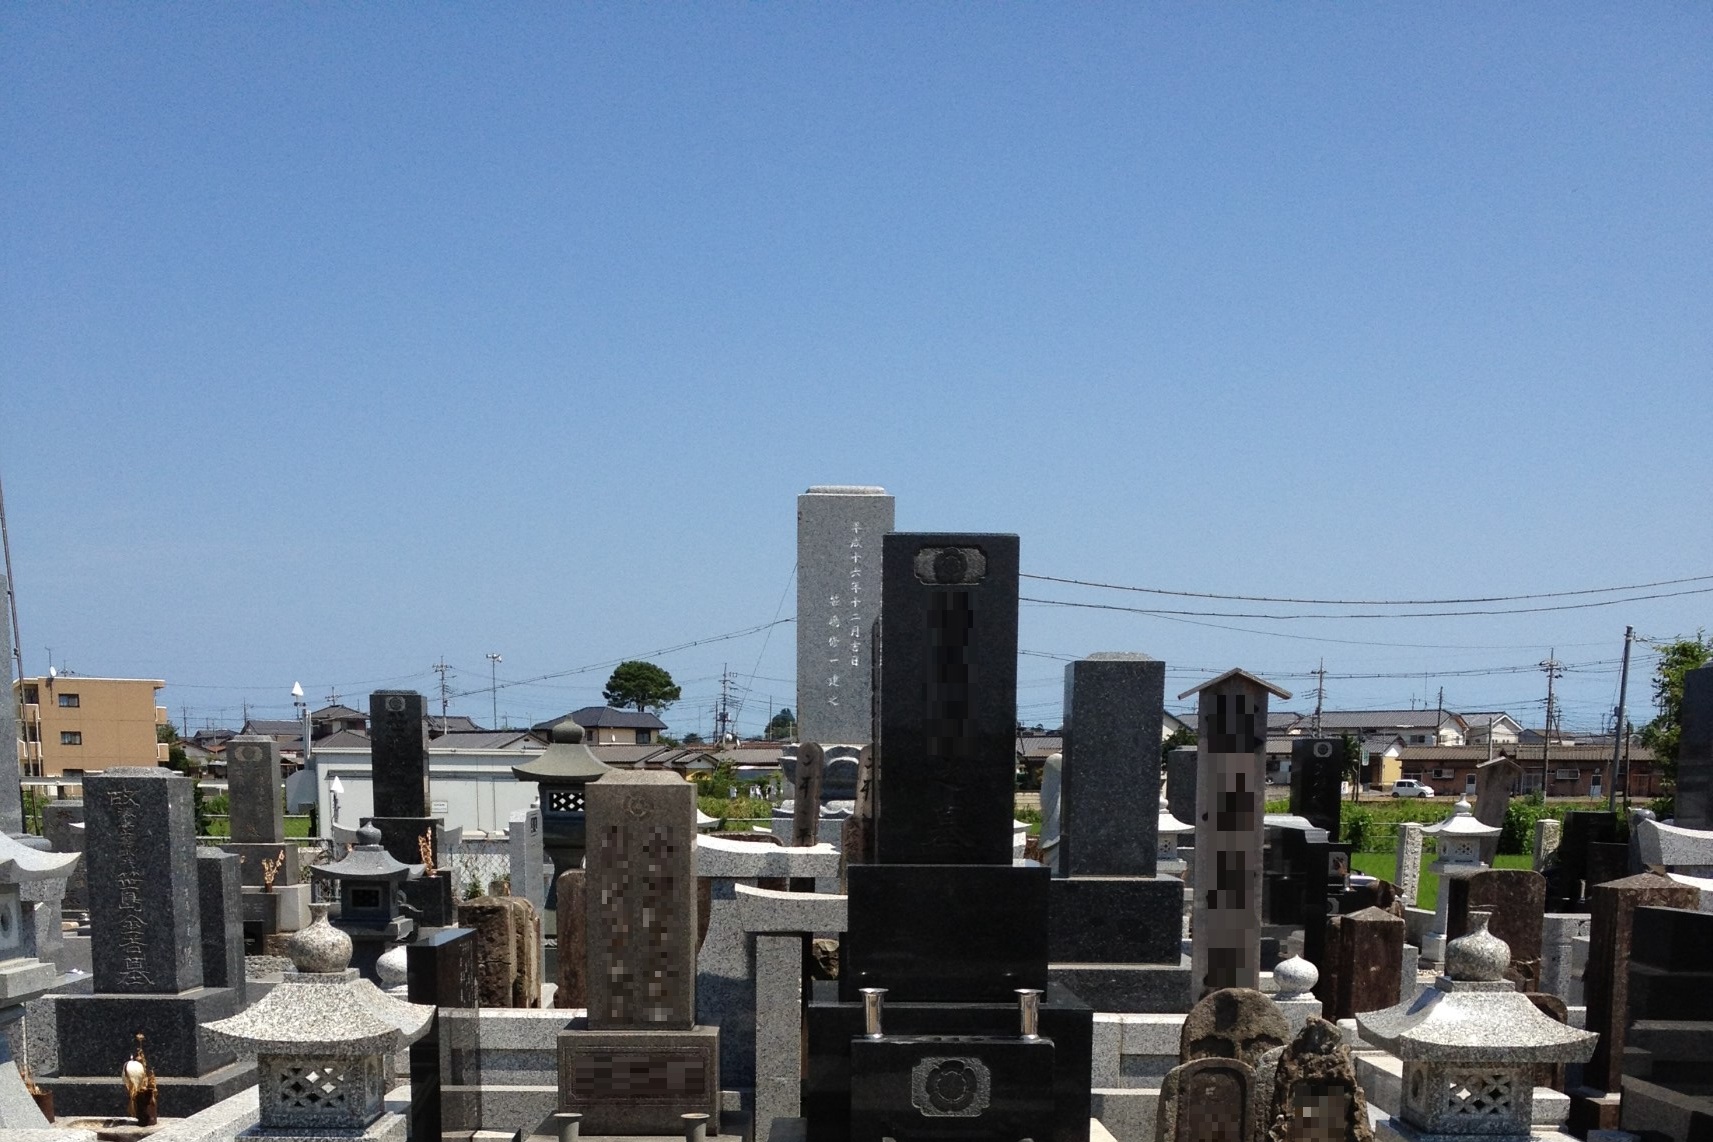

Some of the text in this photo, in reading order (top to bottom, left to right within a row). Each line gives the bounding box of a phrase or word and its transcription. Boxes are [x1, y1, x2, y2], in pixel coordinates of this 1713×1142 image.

[849, 520, 863, 667] 平成十六年十二月吉日
